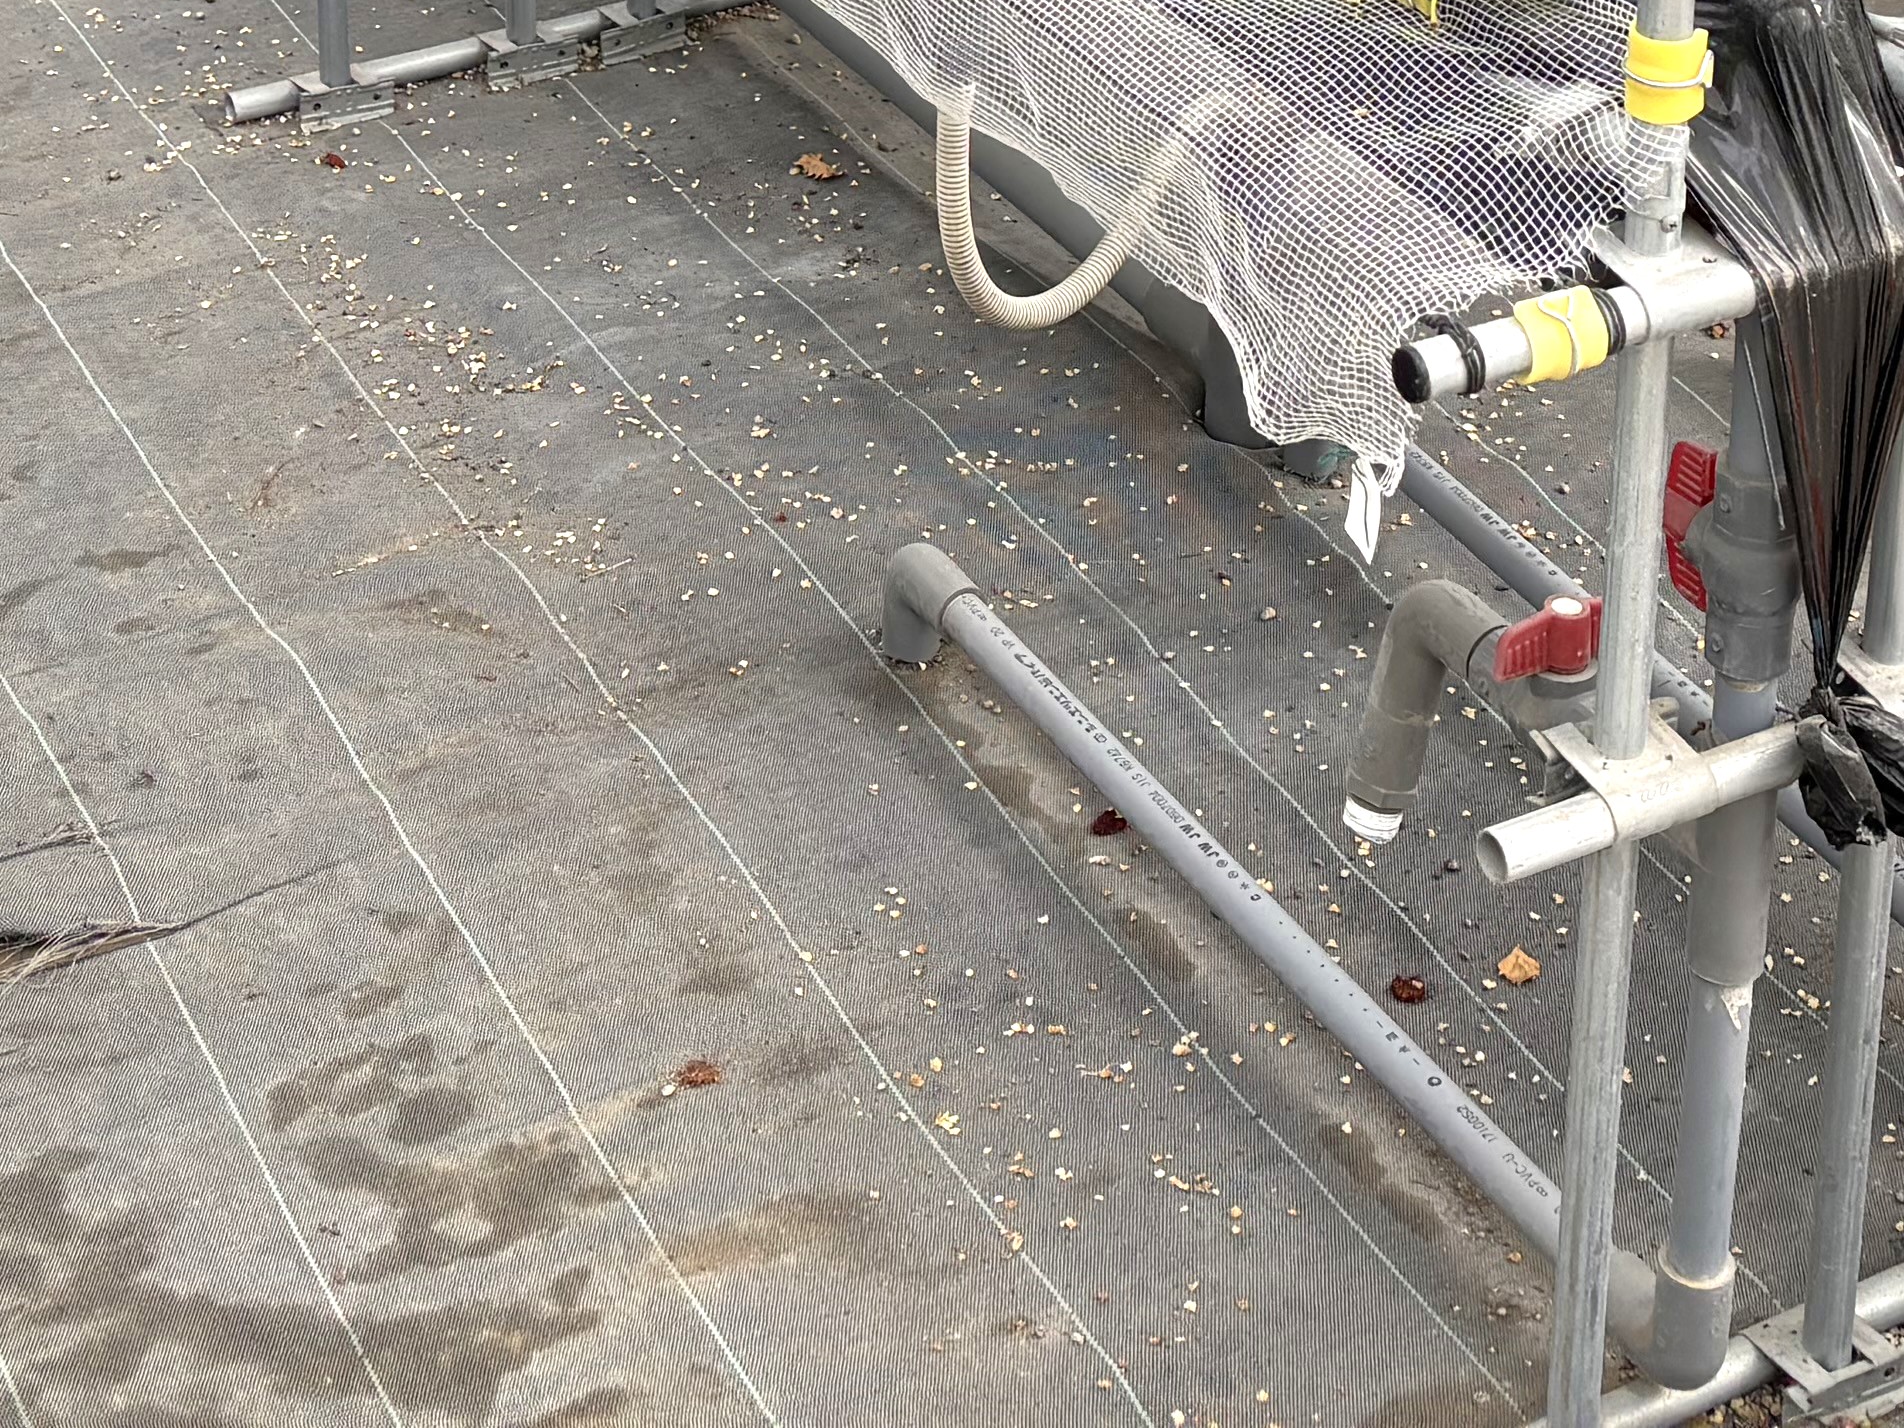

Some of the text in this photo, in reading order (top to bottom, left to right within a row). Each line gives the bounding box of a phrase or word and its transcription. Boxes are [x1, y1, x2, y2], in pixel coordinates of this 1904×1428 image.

[1131, 770, 1150, 790] JIS
[1179, 820, 1200, 841] JW
[1198, 839, 1218, 860] JW
